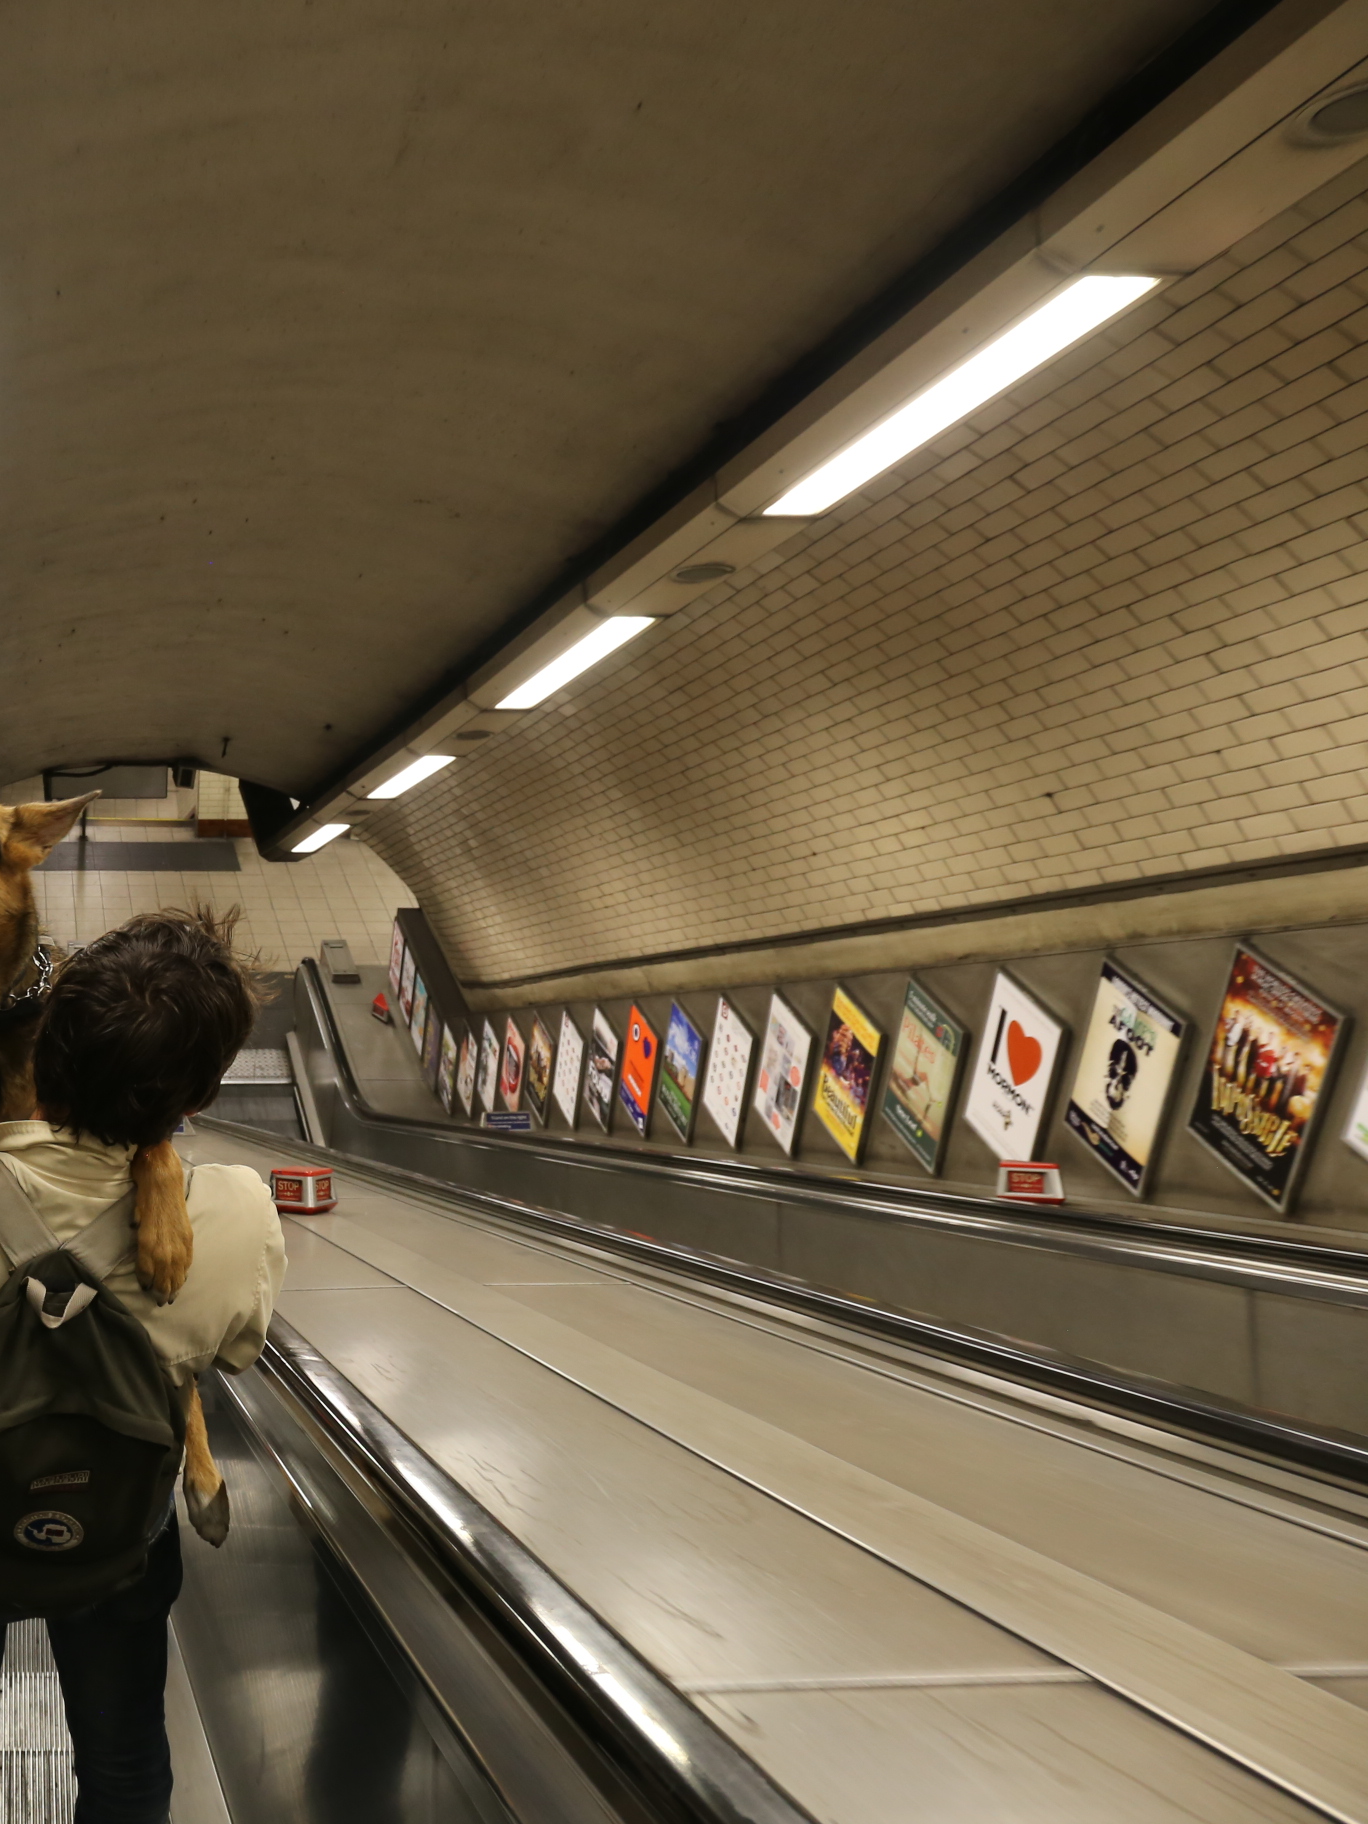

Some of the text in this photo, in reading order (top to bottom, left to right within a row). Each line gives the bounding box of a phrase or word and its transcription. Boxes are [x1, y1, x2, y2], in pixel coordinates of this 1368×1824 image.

[990, 1005, 1007, 1064] I
[1108, 1014, 1155, 1057] AFOOT
[986, 1061, 1034, 1118] MORMON
[277, 1180, 300, 1191] STOP
[315, 1180, 330, 1191] STOP
[1011, 1172, 1041, 1183] STOP
